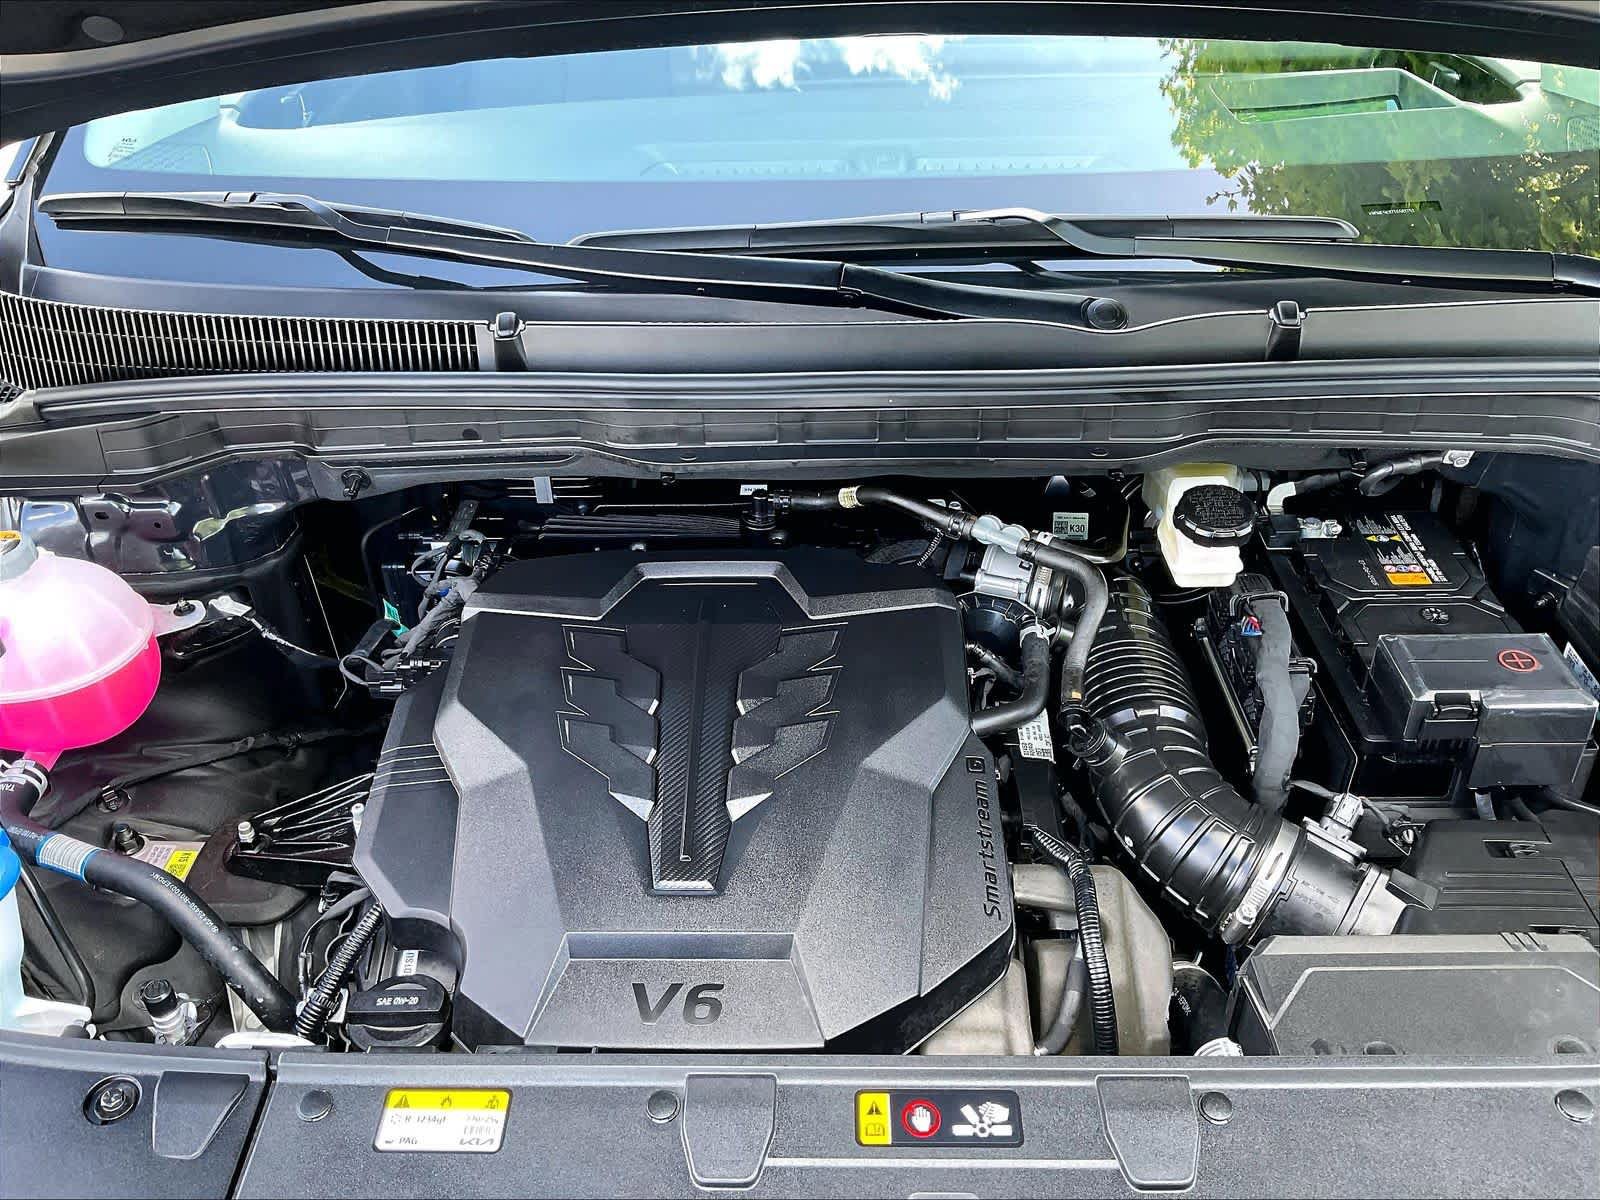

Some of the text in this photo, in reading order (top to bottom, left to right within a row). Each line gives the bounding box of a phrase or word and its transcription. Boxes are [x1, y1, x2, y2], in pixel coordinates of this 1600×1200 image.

[1069, 524, 1085, 533] K30
[976, 778, 1002, 921] Smartstream
[375, 997, 393, 1006] SAE
[631, 982, 725, 1025] V6
